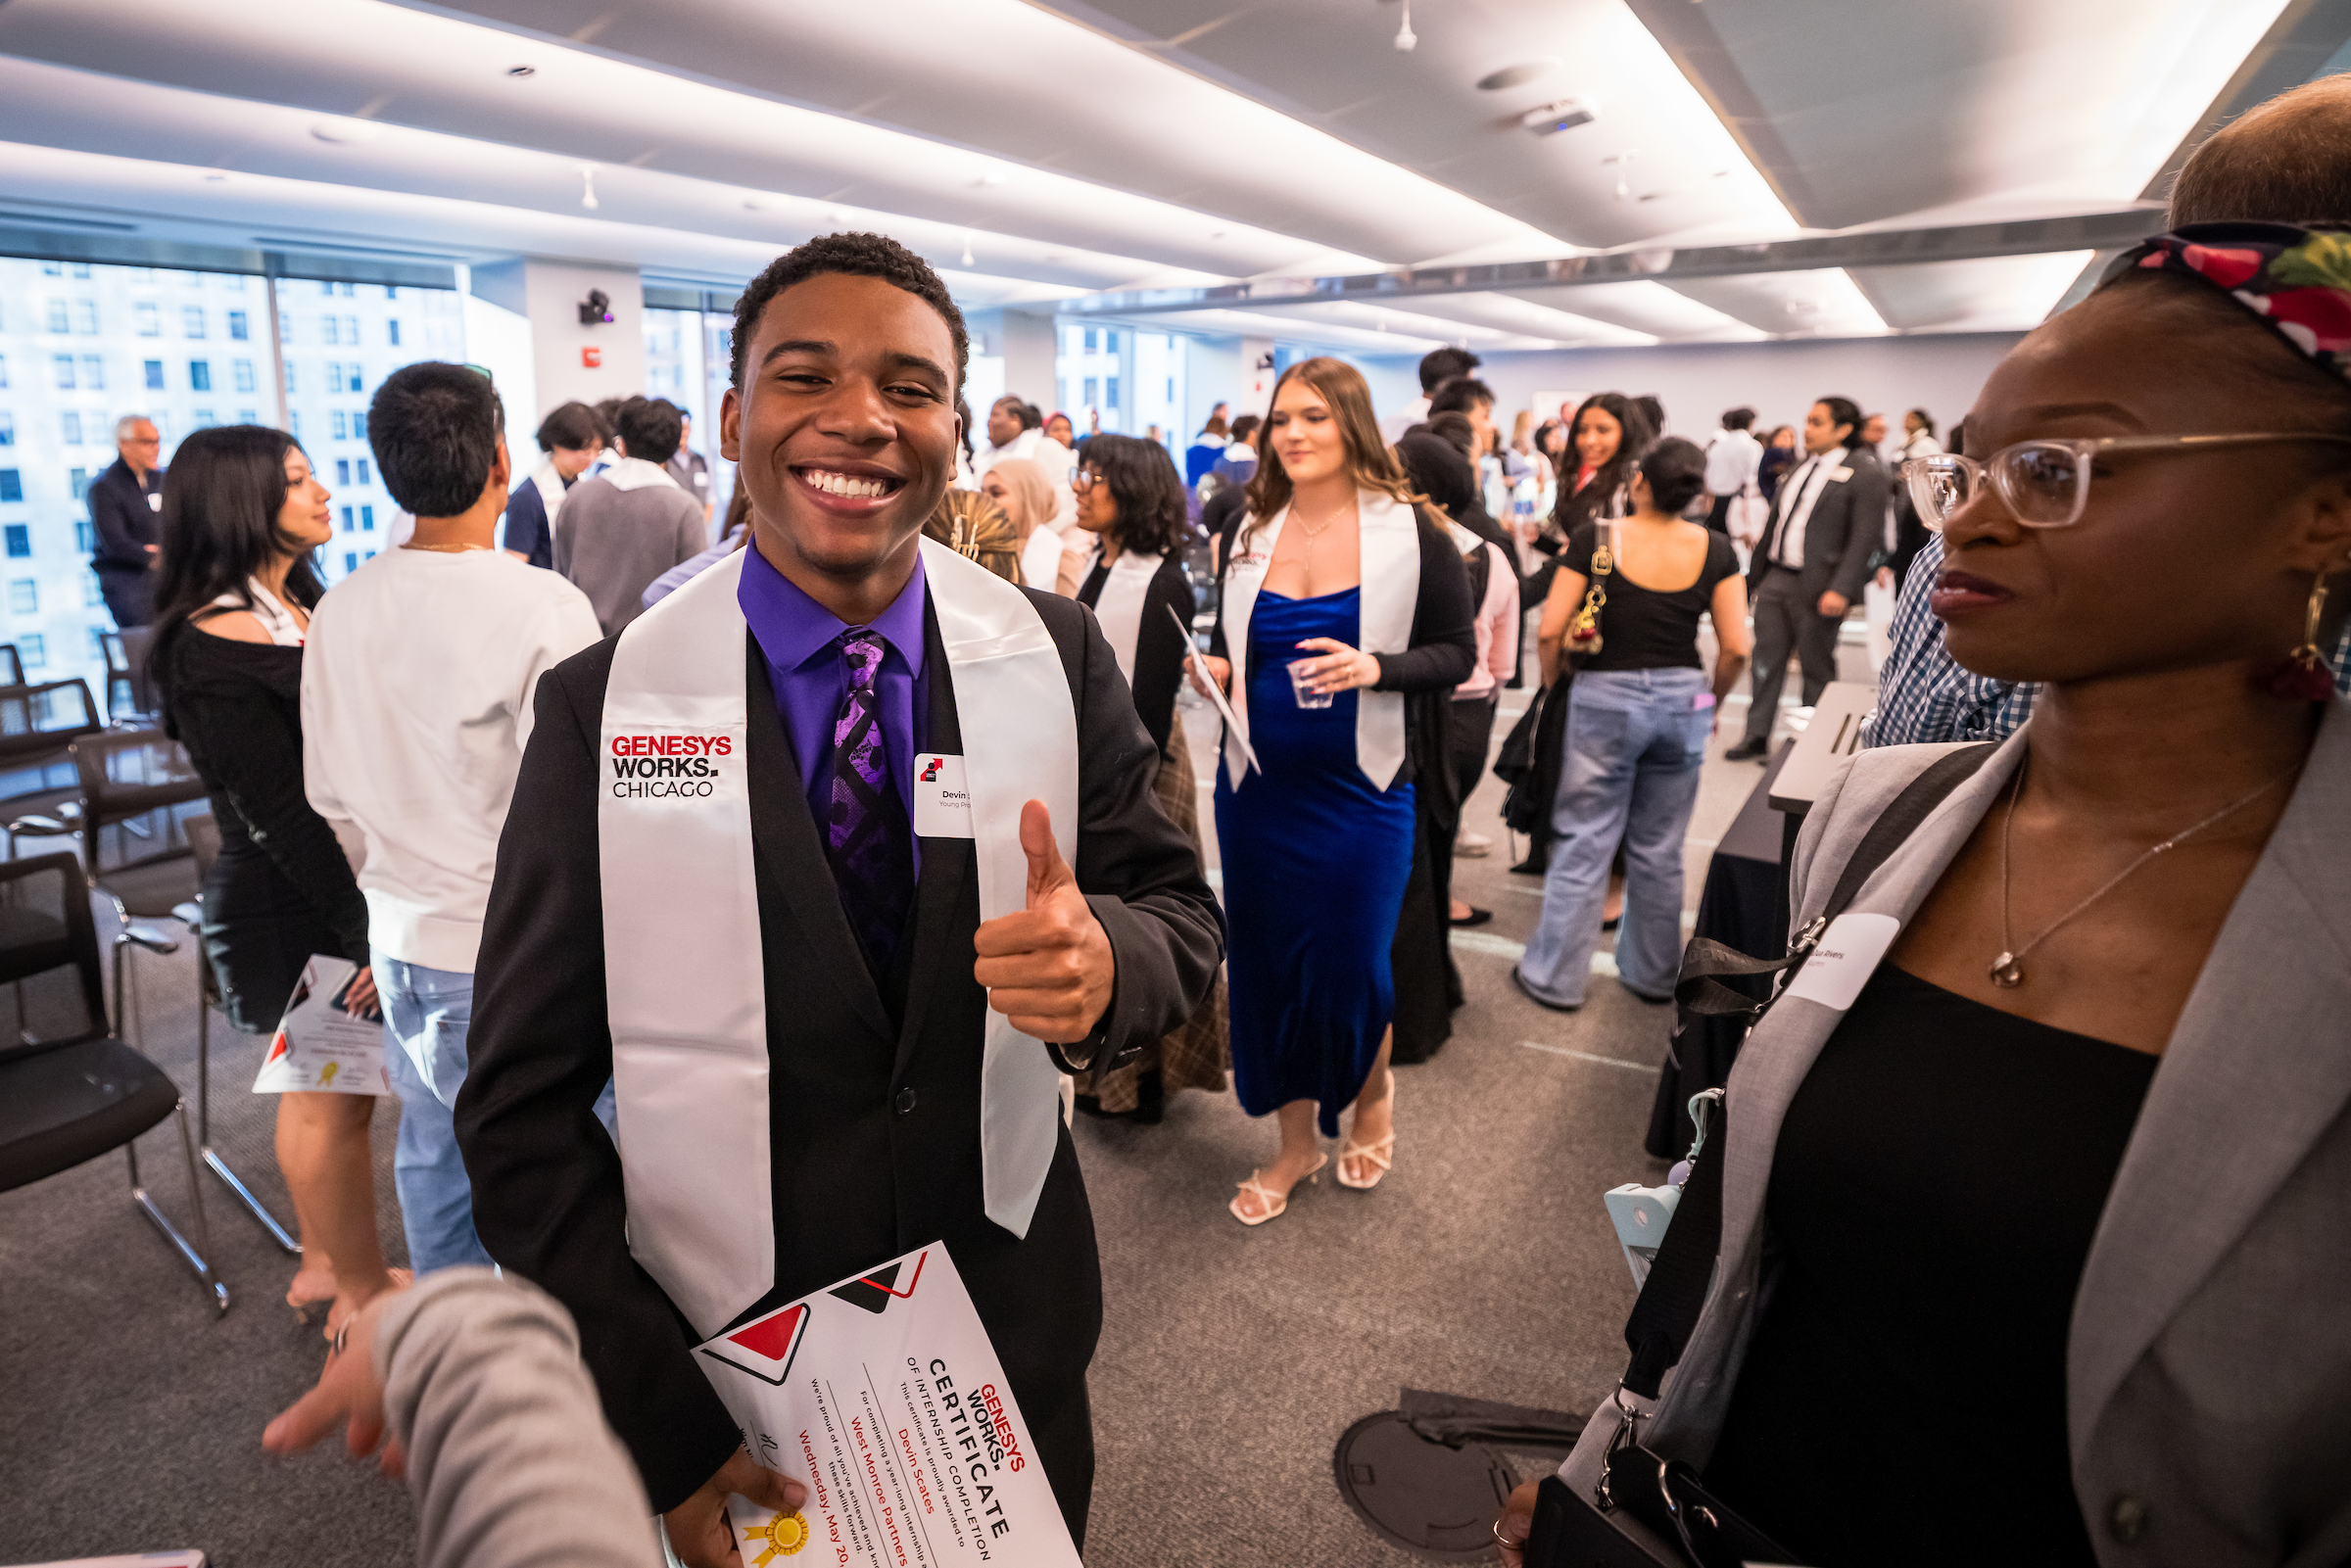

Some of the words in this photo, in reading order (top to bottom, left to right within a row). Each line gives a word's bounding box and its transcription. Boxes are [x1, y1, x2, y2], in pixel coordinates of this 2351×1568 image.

[611, 736, 732, 756] GENESYS
[612, 758, 718, 778] WORKS.
[613, 781, 713, 797] CHICAGO
[942, 790, 966, 799] Devin
[1823, 950, 1845, 960] Rivers
[810, 1378, 824, 1404] We're
[899, 1381, 911, 1401] This
[818, 1405, 835, 1433] proud
[906, 1402, 928, 1447] certificate
[966, 1388, 1005, 1472] WORKS.
[981, 1383, 1026, 1473] GENESYS
[830, 1434, 840, 1444] of
[833, 1445, 843, 1457] all
[924, 1447, 932, 1456] is
[929, 1357, 1011, 1540] CERTIFICATE
[836, 1457, 852, 1488] you've
[897, 1428, 918, 1468] Devin
[913, 1468, 935, 1515] Scates
[906, 1356, 921, 1374] OF
[914, 1378, 953, 1460] INTERNSHIP
[948, 1464, 991, 1561] COMPLETION
[798, 1429, 831, 1514] Wednesday,
[825, 1513, 841, 1543] May
[860, 1390, 870, 1405] For
[866, 1406, 888, 1458] completing
[886, 1466, 907, 1512] year-long
[903, 1511, 925, 1562] internship
[927, 1456, 945, 1493] proudly
[828, 1460, 840, 1488] these
[837, 1489, 849, 1513] skills
[845, 1513, 864, 1554] forward.
[850, 1415, 869, 1452] West
[863, 1452, 887, 1505] Monroe
[882, 1505, 908, 1568] Partners
[848, 1489, 869, 1532] achieved
[941, 1494, 962, 1536] awarded
[863, 1533, 876, 1552] and
[957, 1536, 965, 1547] to
